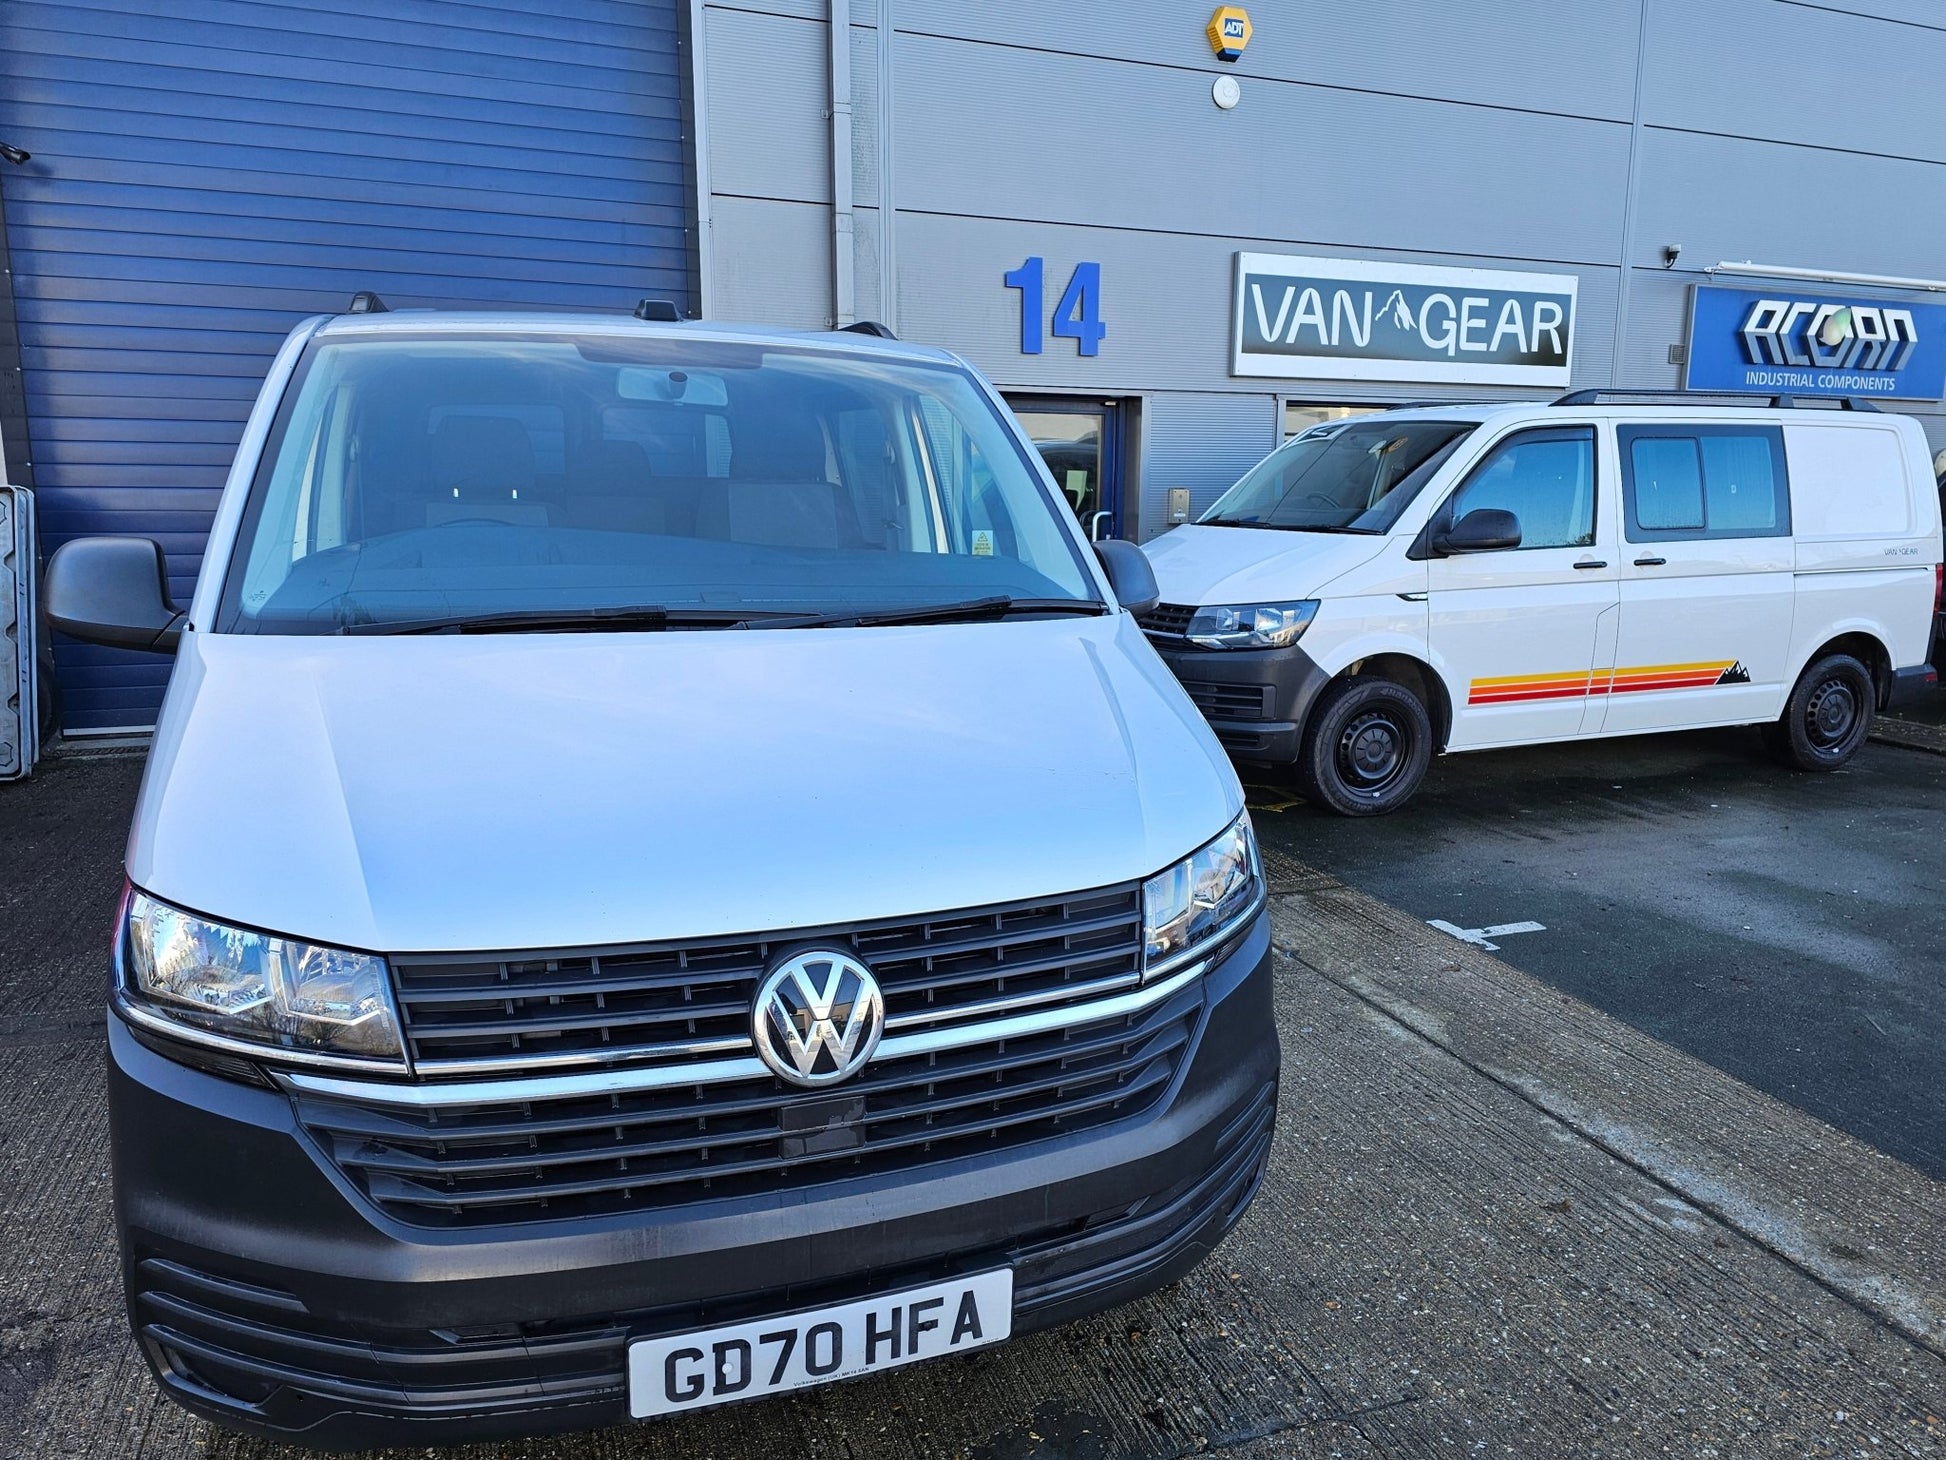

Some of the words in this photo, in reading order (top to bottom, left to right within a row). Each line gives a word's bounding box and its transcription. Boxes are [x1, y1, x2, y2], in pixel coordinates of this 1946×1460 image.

[1224, 21, 1244, 36] ADT
[1004, 256, 1106, 357] 14
[1251, 283, 1373, 348] VAN
[1419, 293, 1563, 357] GEAR
[1741, 299, 1918, 371] ACORN
[1746, 371, 1815, 388] INDUSTRIAL
[1818, 375, 1895, 391] COMPONENTS
[1901, 547, 1919, 556] GEAR
[664, 1321, 842, 1403] GD70
[865, 1290, 983, 1365] HFA
